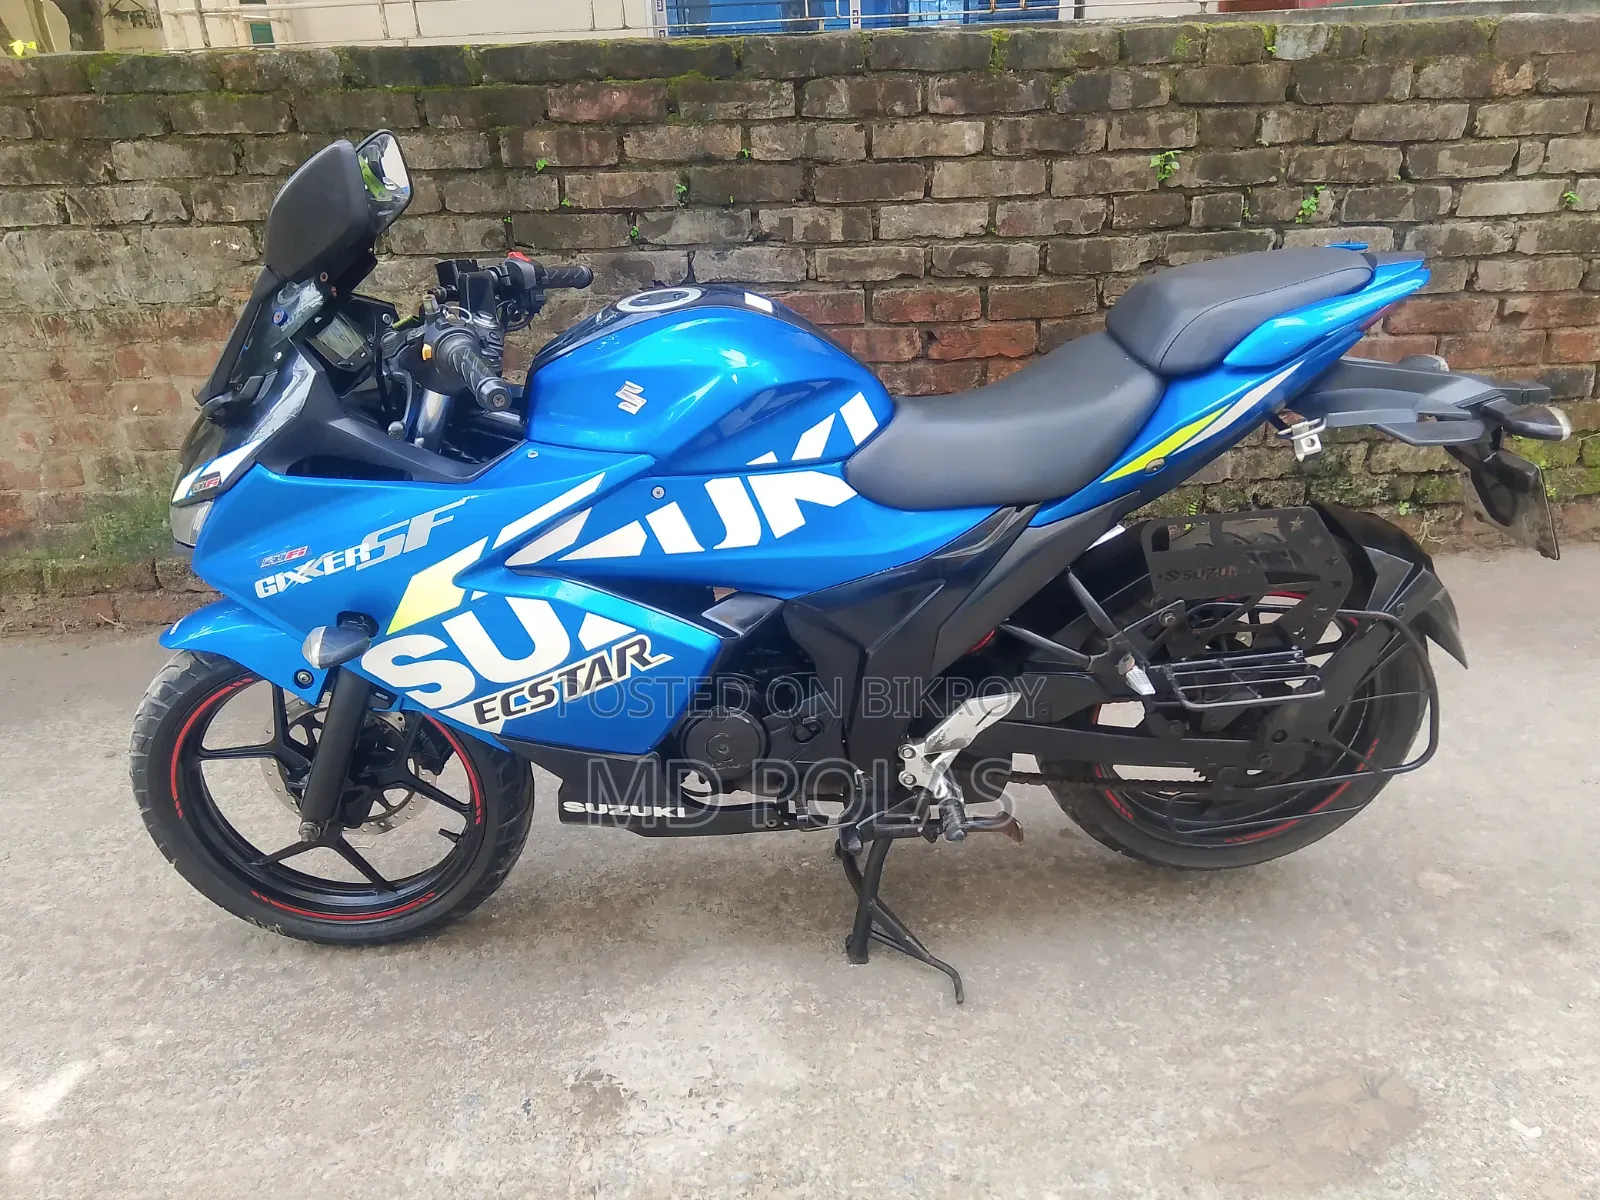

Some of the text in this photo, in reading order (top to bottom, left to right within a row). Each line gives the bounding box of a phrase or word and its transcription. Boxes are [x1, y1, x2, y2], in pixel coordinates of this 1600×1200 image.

[254, 543, 371, 598] GIXXER
[473, 637, 669, 725] ECSTAR
[563, 801, 686, 818] SUZUKI
